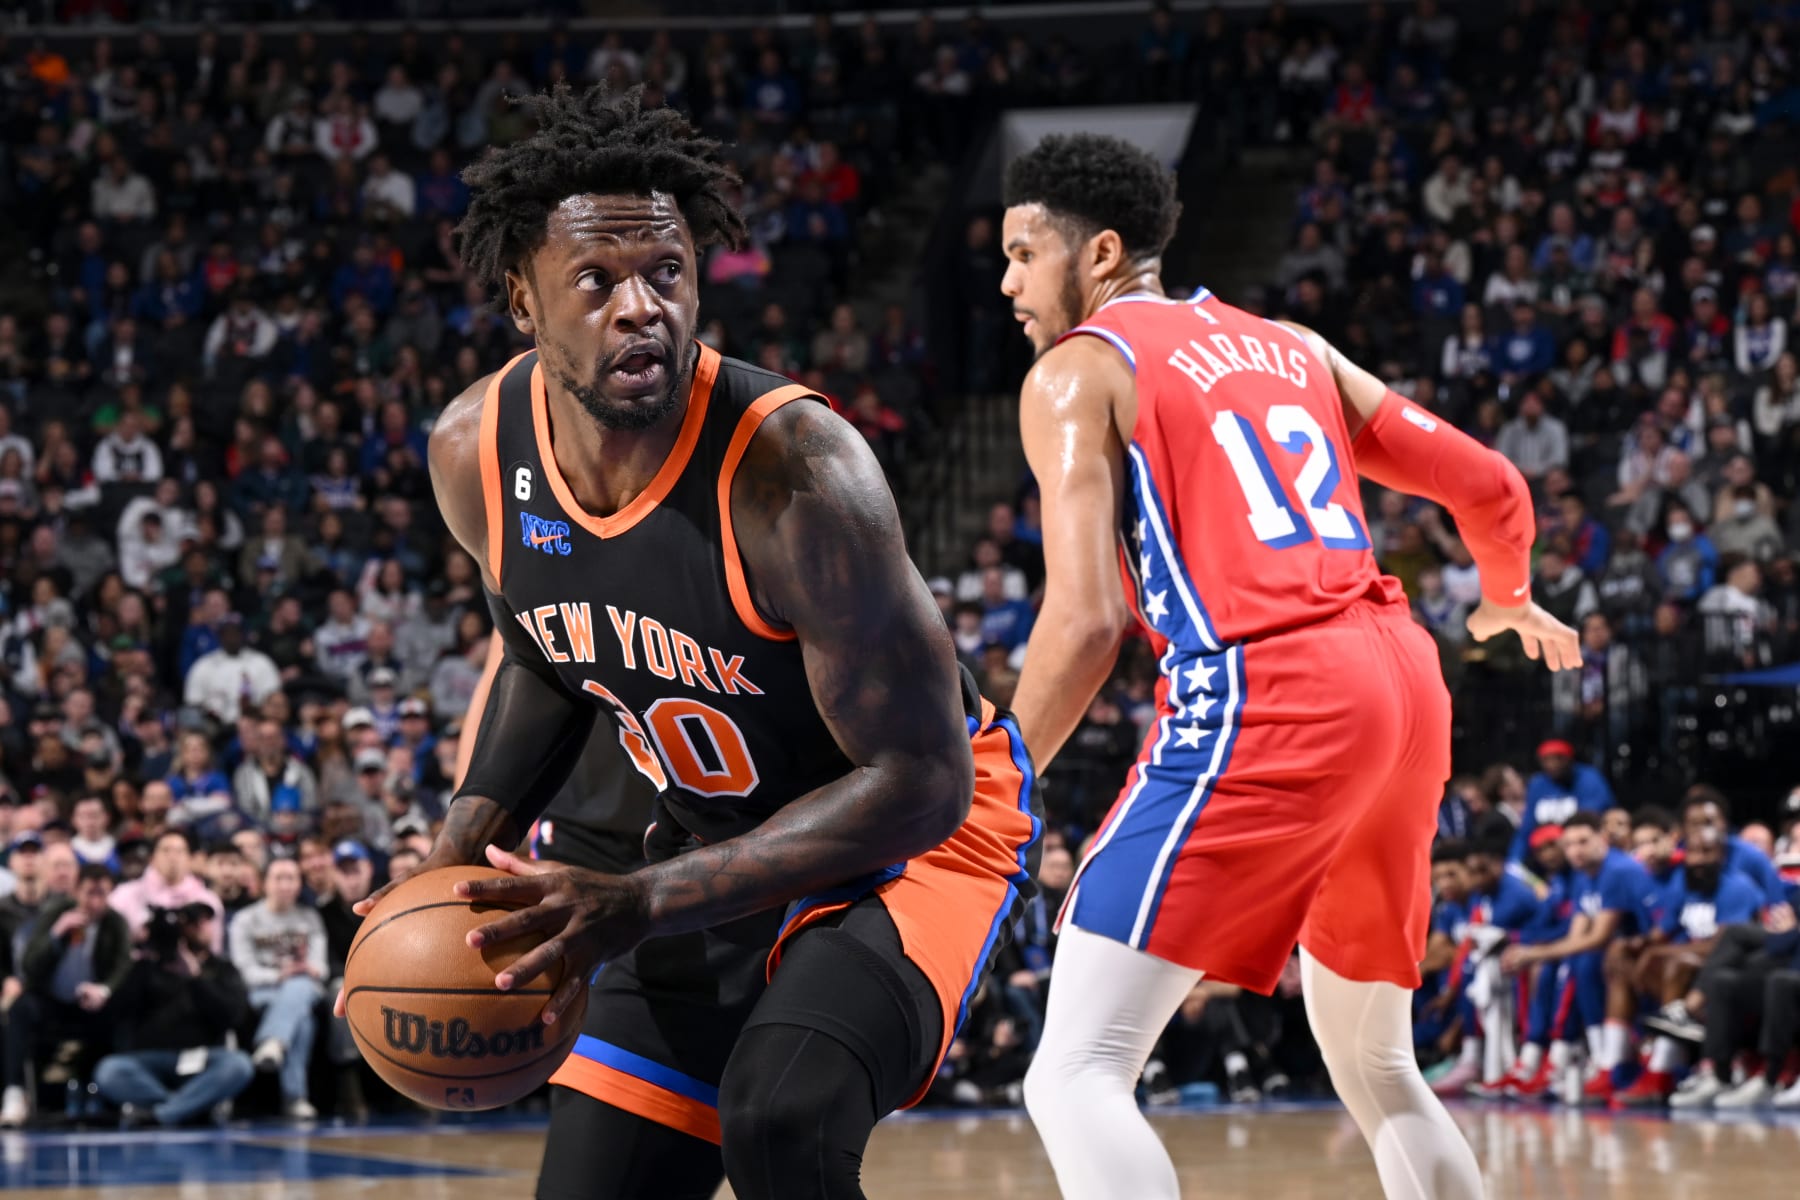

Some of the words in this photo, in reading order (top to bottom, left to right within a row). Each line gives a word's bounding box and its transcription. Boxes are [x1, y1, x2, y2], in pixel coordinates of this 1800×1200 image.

[1167, 333, 1308, 393] HARRIS
[514, 467, 533, 501] 6
[1211, 404, 1373, 550] 12
[520, 511, 572, 556] NYC
[515, 602, 596, 663] NEW
[606, 605, 766, 695] YORK
[381, 1004, 545, 1059] Wilson
